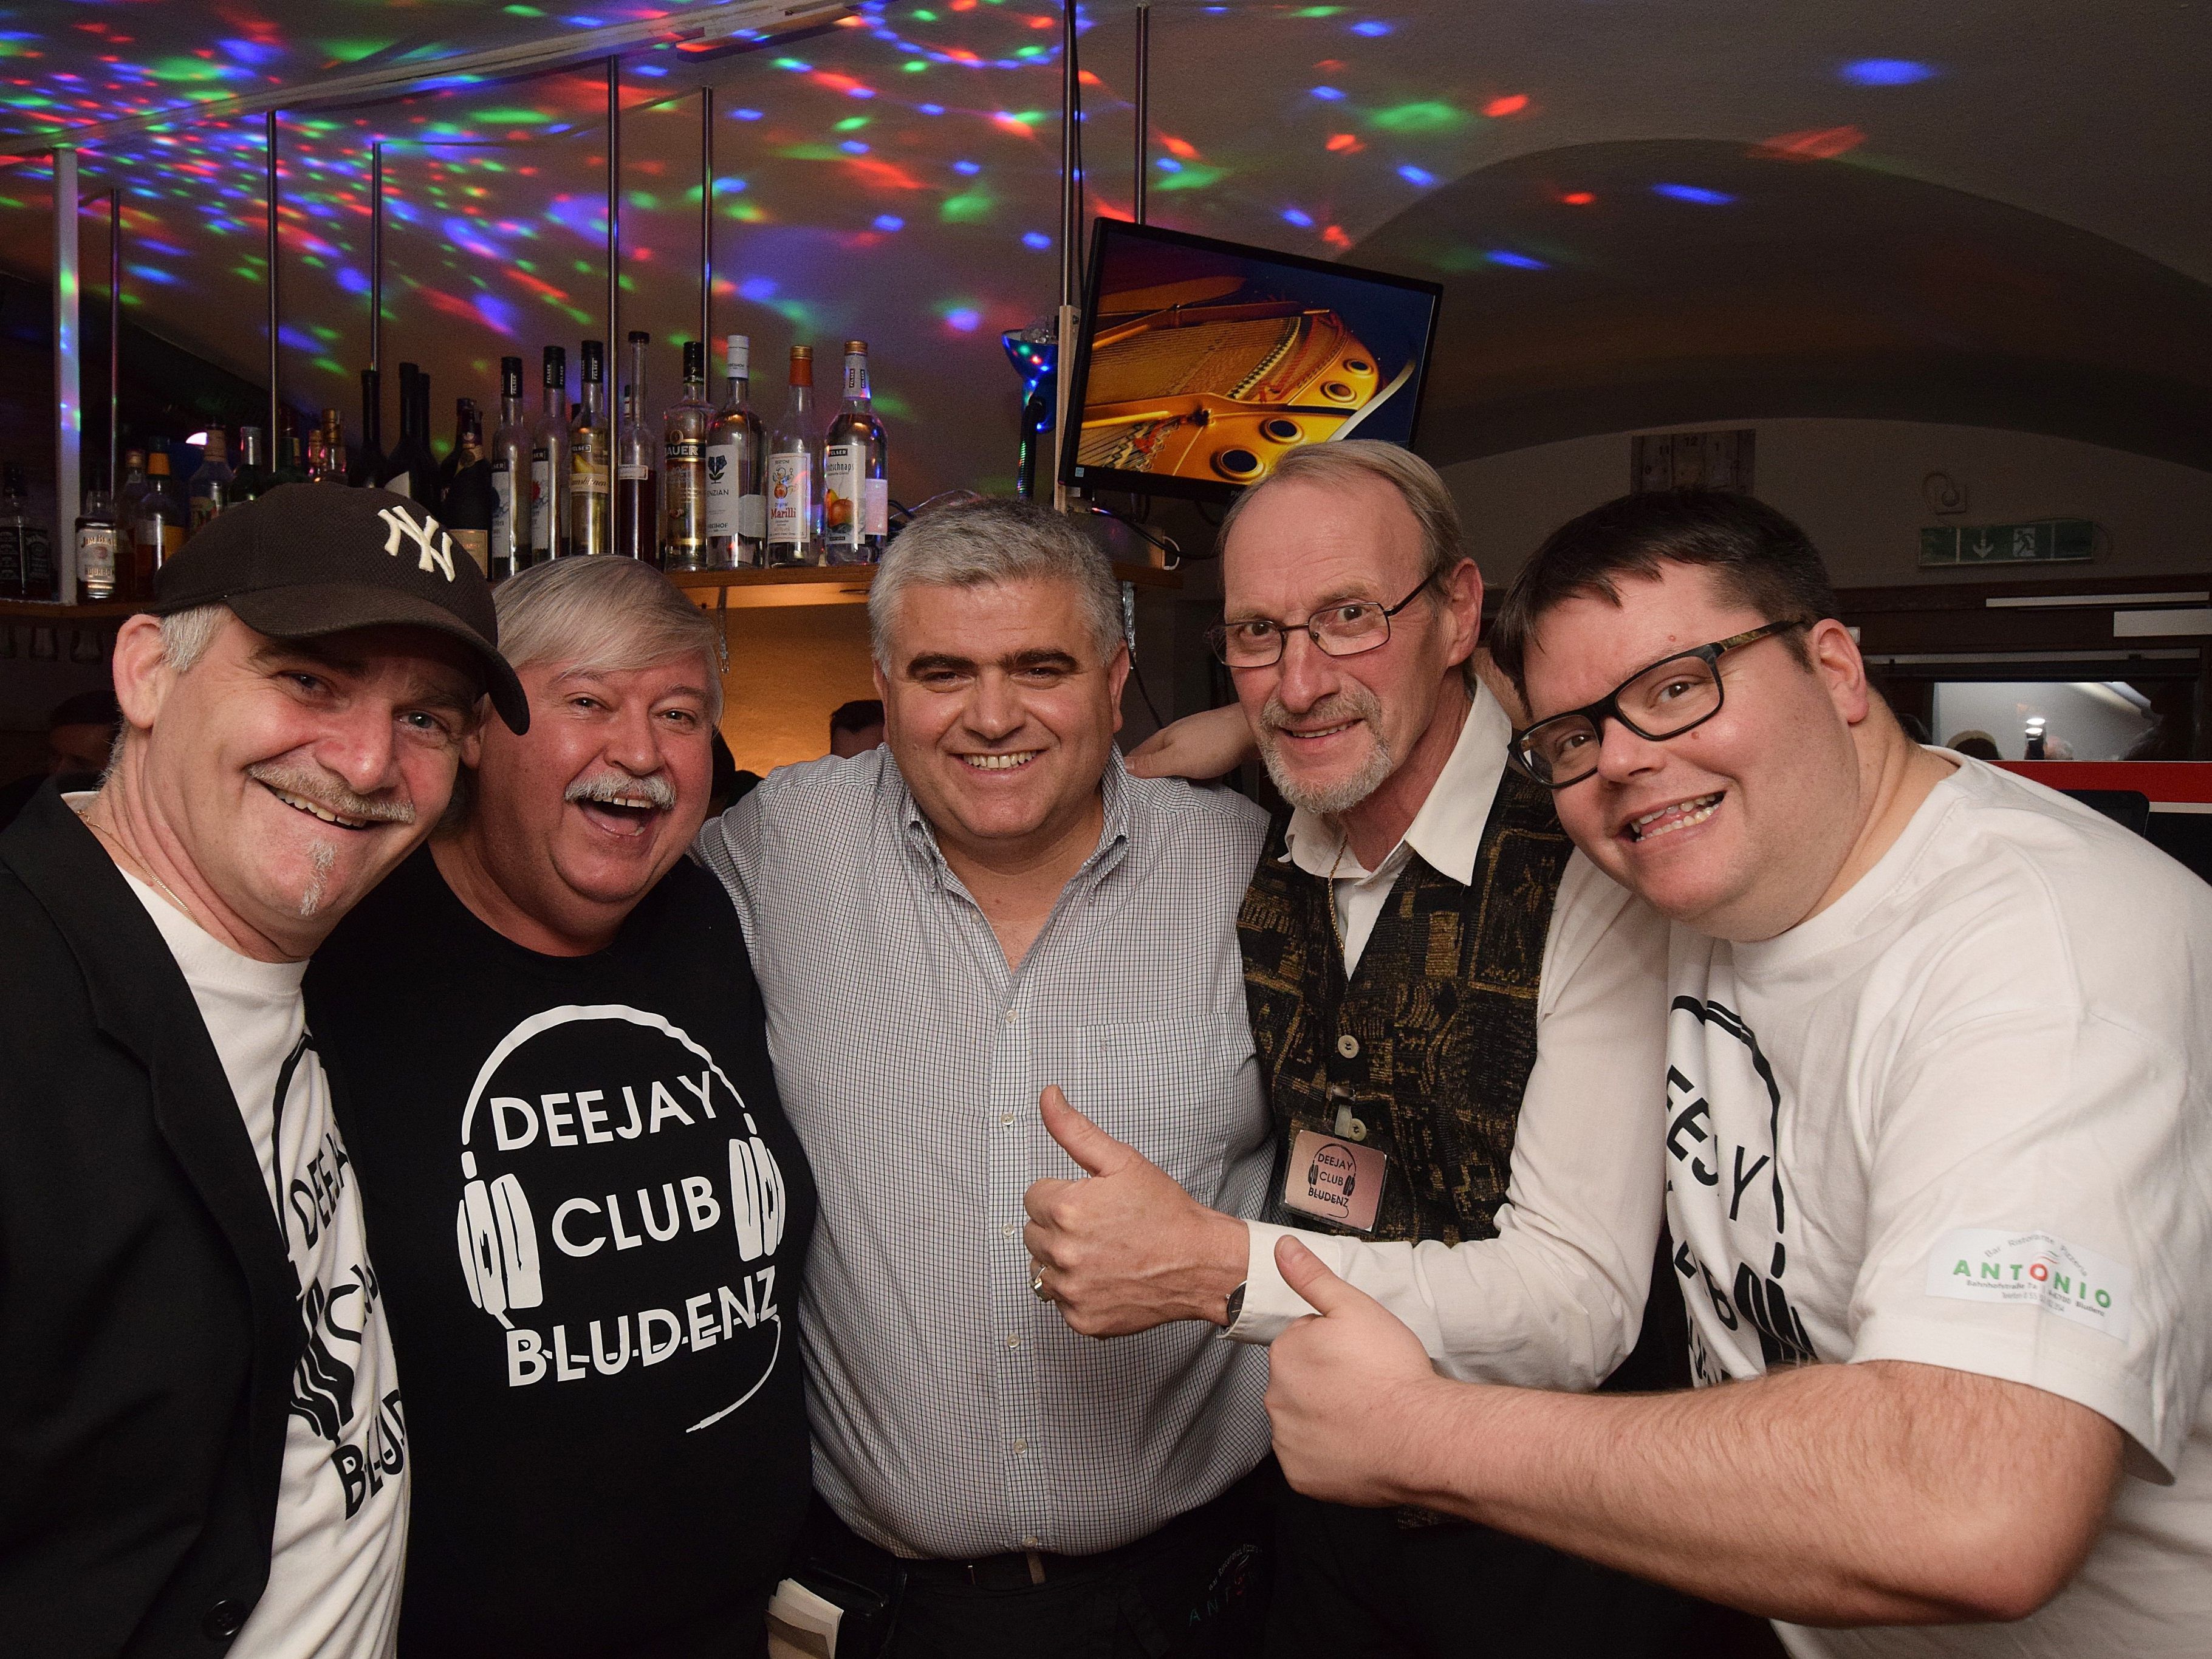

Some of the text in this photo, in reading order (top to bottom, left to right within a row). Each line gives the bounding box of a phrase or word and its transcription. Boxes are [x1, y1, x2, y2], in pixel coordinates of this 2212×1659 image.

[665, 445, 699, 456] AUER
[770, 507, 796, 519] Marilli
[490, 1071, 716, 1151] DEEJAY
[1317, 1153, 1353, 1172] DEEJAY
[1319, 1171, 1344, 1186] CLUB
[1308, 1186, 1349, 1208] BLUDENZ
[552, 1176, 721, 1257] CLUB
[1984, 1245, 2002, 1258] Bar
[1953, 1259, 2112, 1309] ANTONIO
[506, 1265, 778, 1387] BLUDENZ
